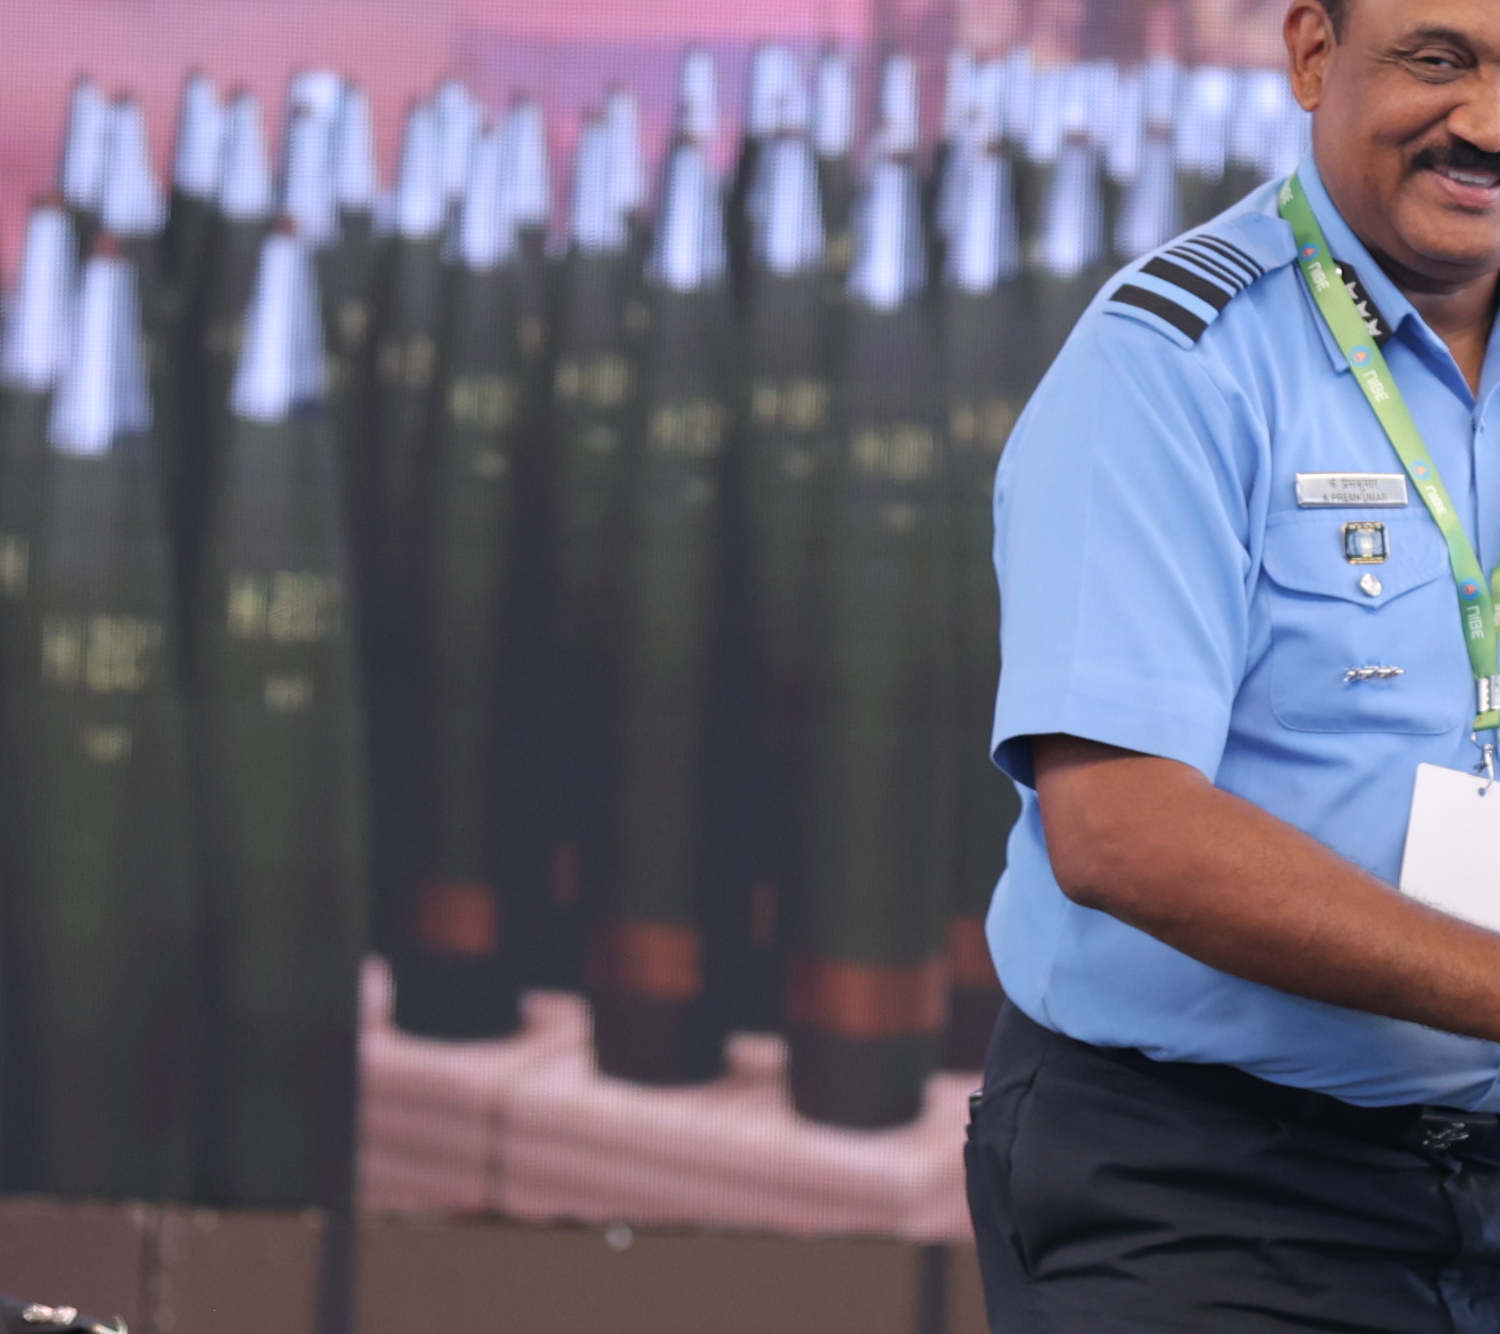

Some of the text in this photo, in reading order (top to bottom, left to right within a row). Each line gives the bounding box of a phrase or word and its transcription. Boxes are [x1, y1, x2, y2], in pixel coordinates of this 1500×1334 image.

[1308, 262, 1331, 292] NIBE
[1364, 369, 1389, 403] NIBE
[1424, 485, 1448, 516] NIBE
[1466, 605, 1485, 640] NIBE
